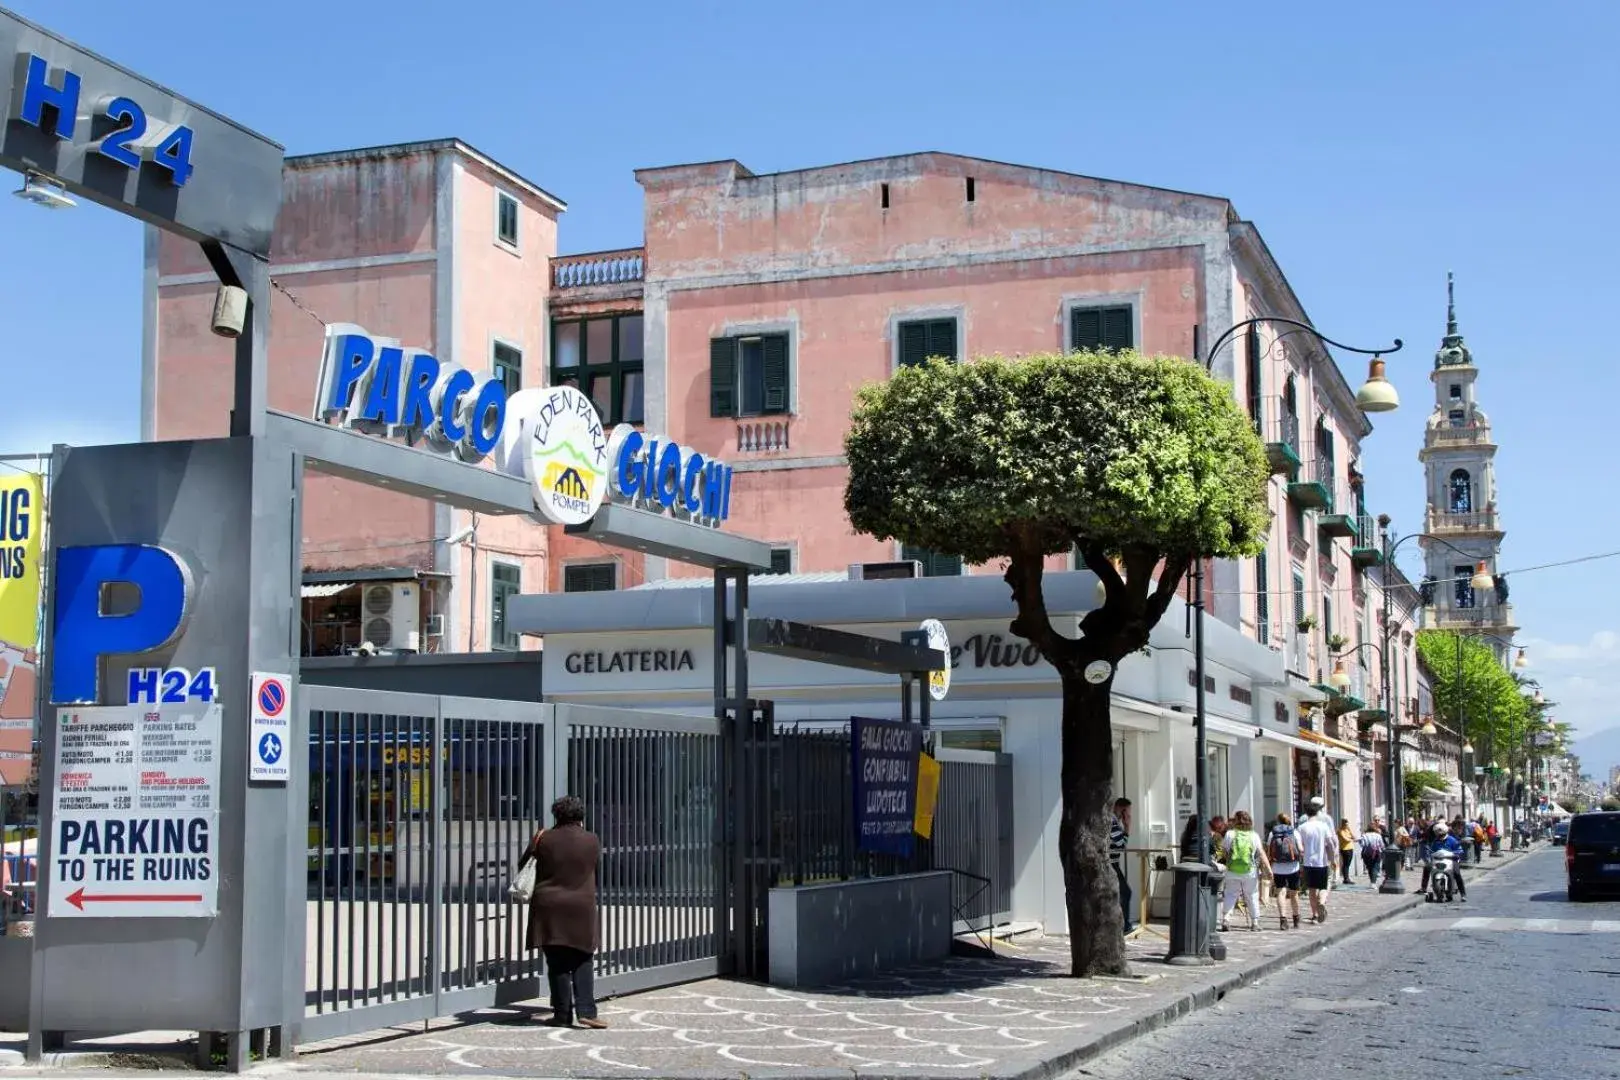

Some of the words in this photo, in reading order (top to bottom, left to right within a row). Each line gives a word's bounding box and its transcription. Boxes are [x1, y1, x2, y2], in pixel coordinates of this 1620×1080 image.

[327, 334, 506, 455] PARCO
[617, 431, 732, 521] GIOCHI
[534, 390, 572, 445] EDEN
[576, 396, 606, 465] PARK
[552, 492, 590, 515] POMPEI
[51, 543, 186, 704] P
[565, 650, 694, 674] GELATERIA
[964, 634, 1040, 668] Vivo
[128, 667, 216, 704] H24
[62, 724, 89, 732] TARIFFE
[90, 724, 134, 732] PARCHEGGIO
[143, 723, 173, 731] PARKING
[861, 726, 882, 750] SALA
[883, 728, 912, 752] GIOCHI
[863, 757, 910, 783] GONFIABILI
[866, 789, 907, 814] LUDOTECA
[59, 818, 209, 855] PARKING
[58, 859, 85, 881] TO
[93, 858, 135, 881] THE
[143, 857, 211, 881] RUINS
